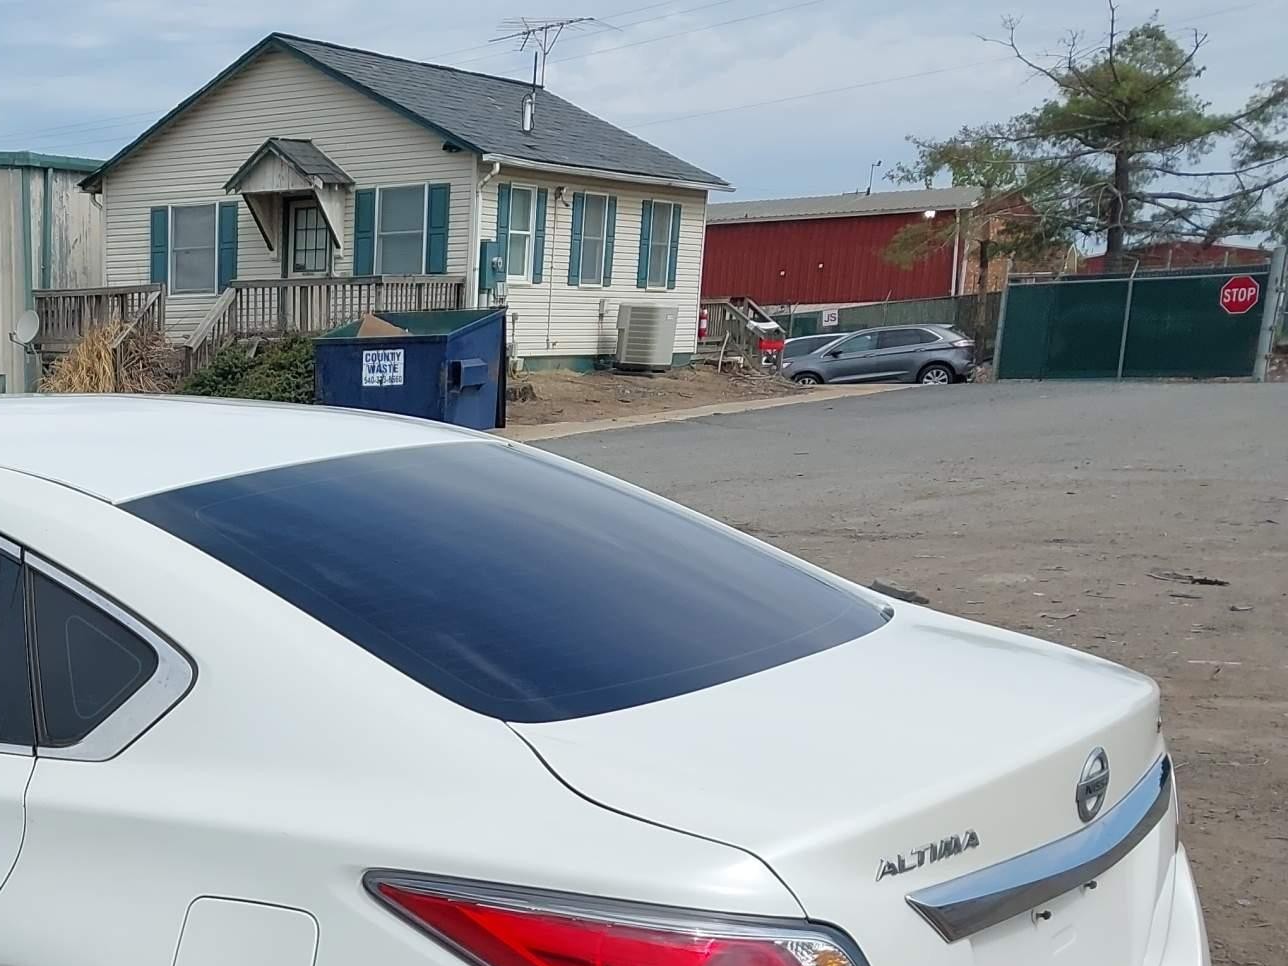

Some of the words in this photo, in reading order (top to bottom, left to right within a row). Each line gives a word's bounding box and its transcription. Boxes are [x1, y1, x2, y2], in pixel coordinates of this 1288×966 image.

[1223, 287, 1256, 303] STOP
[824, 312, 837, 323] JS
[365, 351, 402, 362] COUNTY
[367, 363, 399, 374] WASTE
[875, 828, 980, 882] ALTIMA
